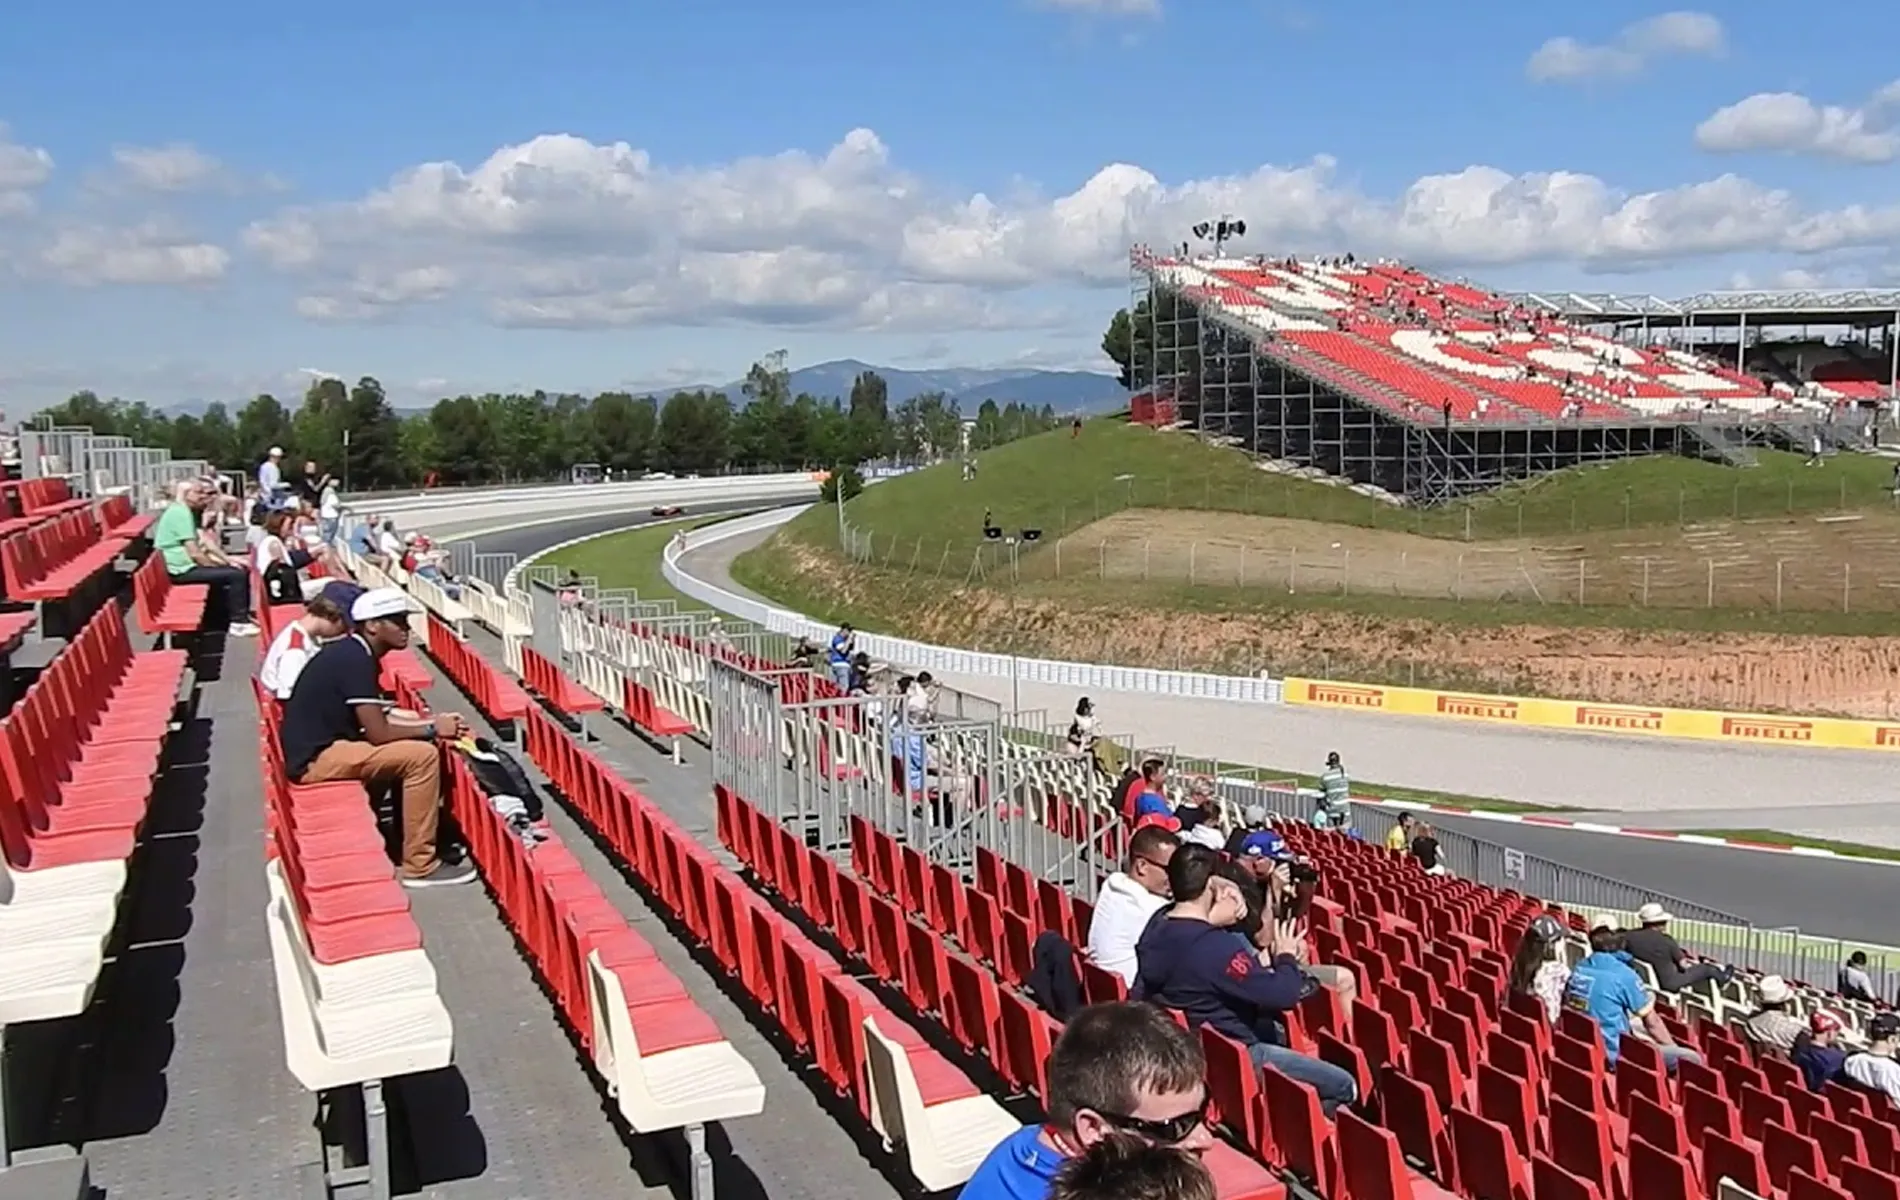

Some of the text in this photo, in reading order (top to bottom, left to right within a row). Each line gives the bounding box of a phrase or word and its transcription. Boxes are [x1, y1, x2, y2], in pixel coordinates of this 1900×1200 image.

[1309, 684, 1384, 707] PIRELLI
[1437, 695, 1518, 719] PIRELLI
[1576, 707, 1663, 730] PIRELLI
[1722, 718, 1813, 740] PIRELLI
